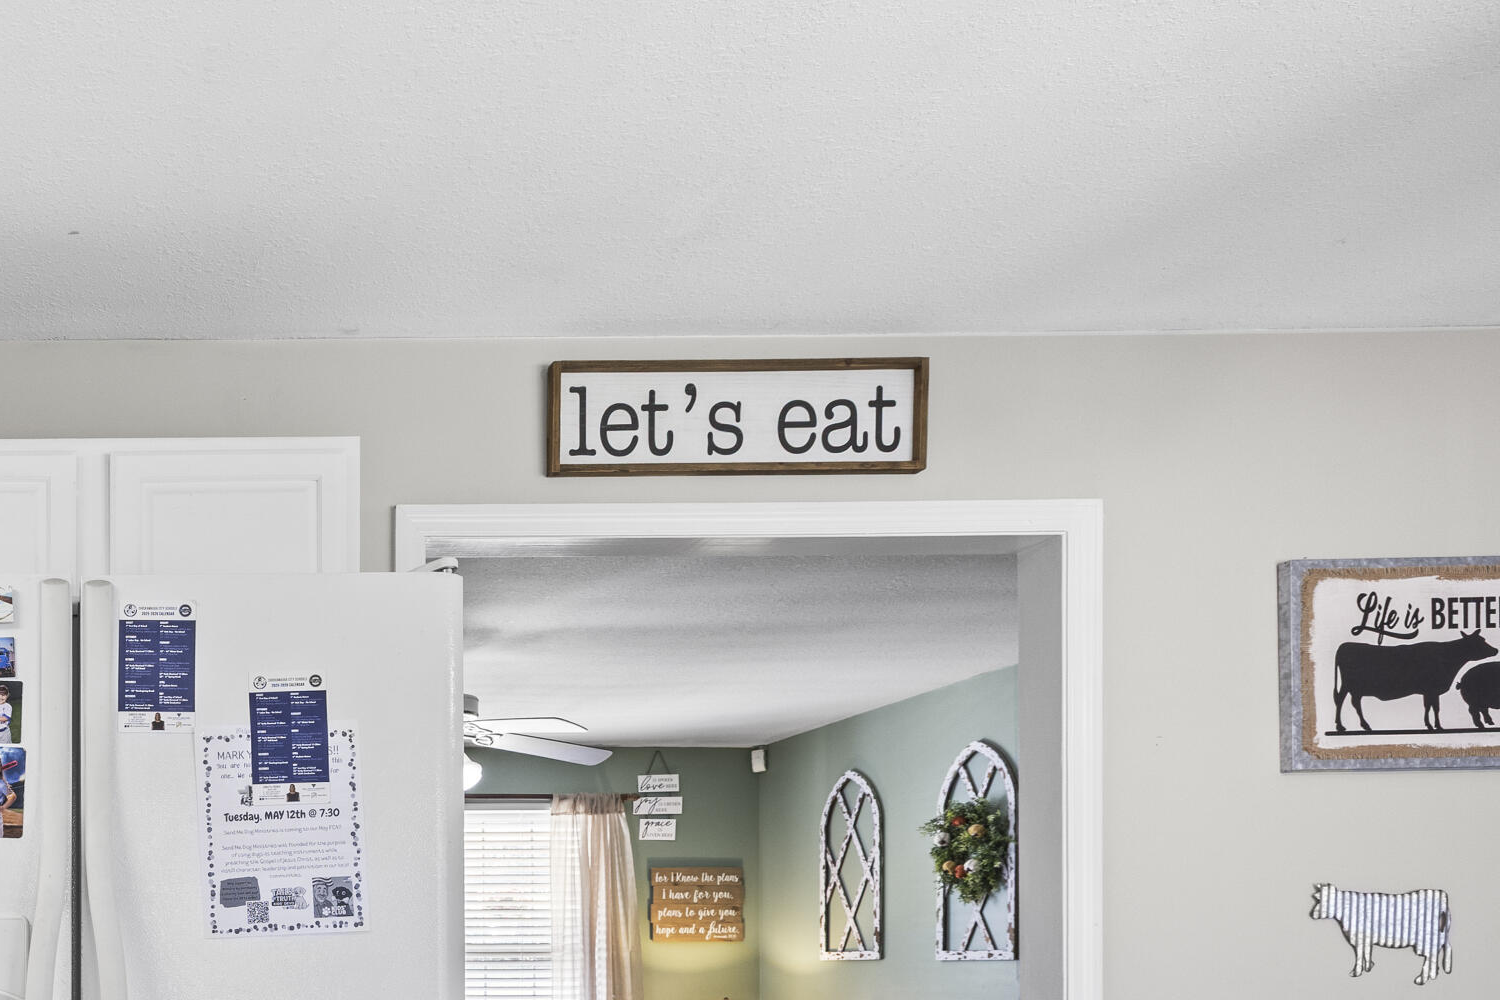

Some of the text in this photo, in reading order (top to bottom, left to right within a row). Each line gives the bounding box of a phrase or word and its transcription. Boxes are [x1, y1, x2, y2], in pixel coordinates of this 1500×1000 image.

[569, 383, 901, 457] let's eat
[1351, 591, 1500, 645] Life is BETTE
[217, 750, 245, 760] MARK
[641, 776, 665, 791] love
[265, 810, 284, 820] MAY
[287, 809, 306, 819] 12th
[309, 809, 317, 818] @
[320, 808, 340, 817] 7:30
[642, 821, 672, 838] grace
[702, 872, 715, 881] the
[717, 872, 739, 885] plans
[662, 888, 666, 899] I
[669, 889, 691, 900] have
[693, 889, 711, 903] for
[658, 907, 737, 920] plans to give you
[656, 924, 676, 938] hope
[679, 923, 696, 934] and
